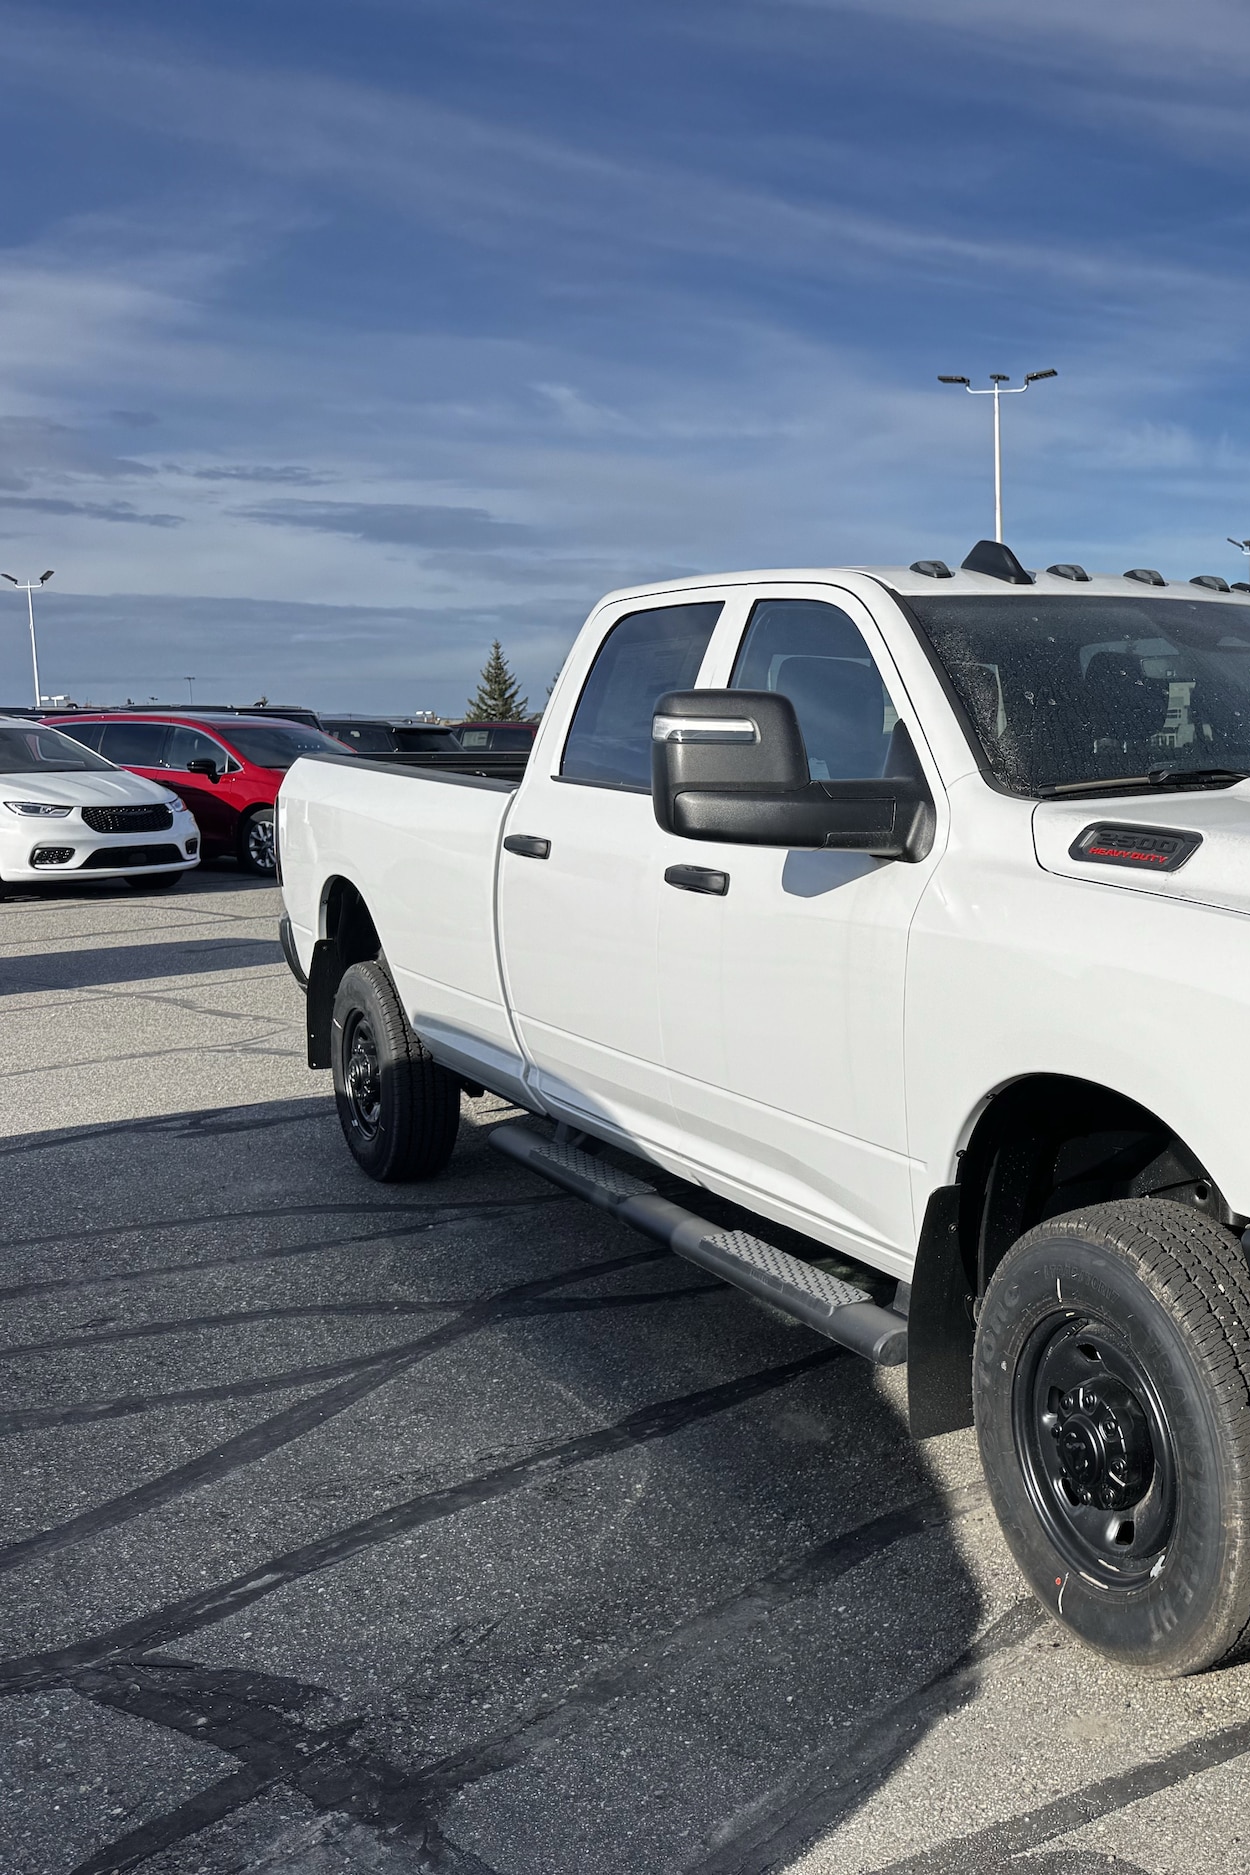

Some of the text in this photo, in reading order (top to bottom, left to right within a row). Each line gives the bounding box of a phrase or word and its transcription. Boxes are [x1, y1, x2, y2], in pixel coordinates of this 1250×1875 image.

[1097, 833, 1178, 853] 2500
[1088, 846, 1168, 863] HEAVY DUTY
